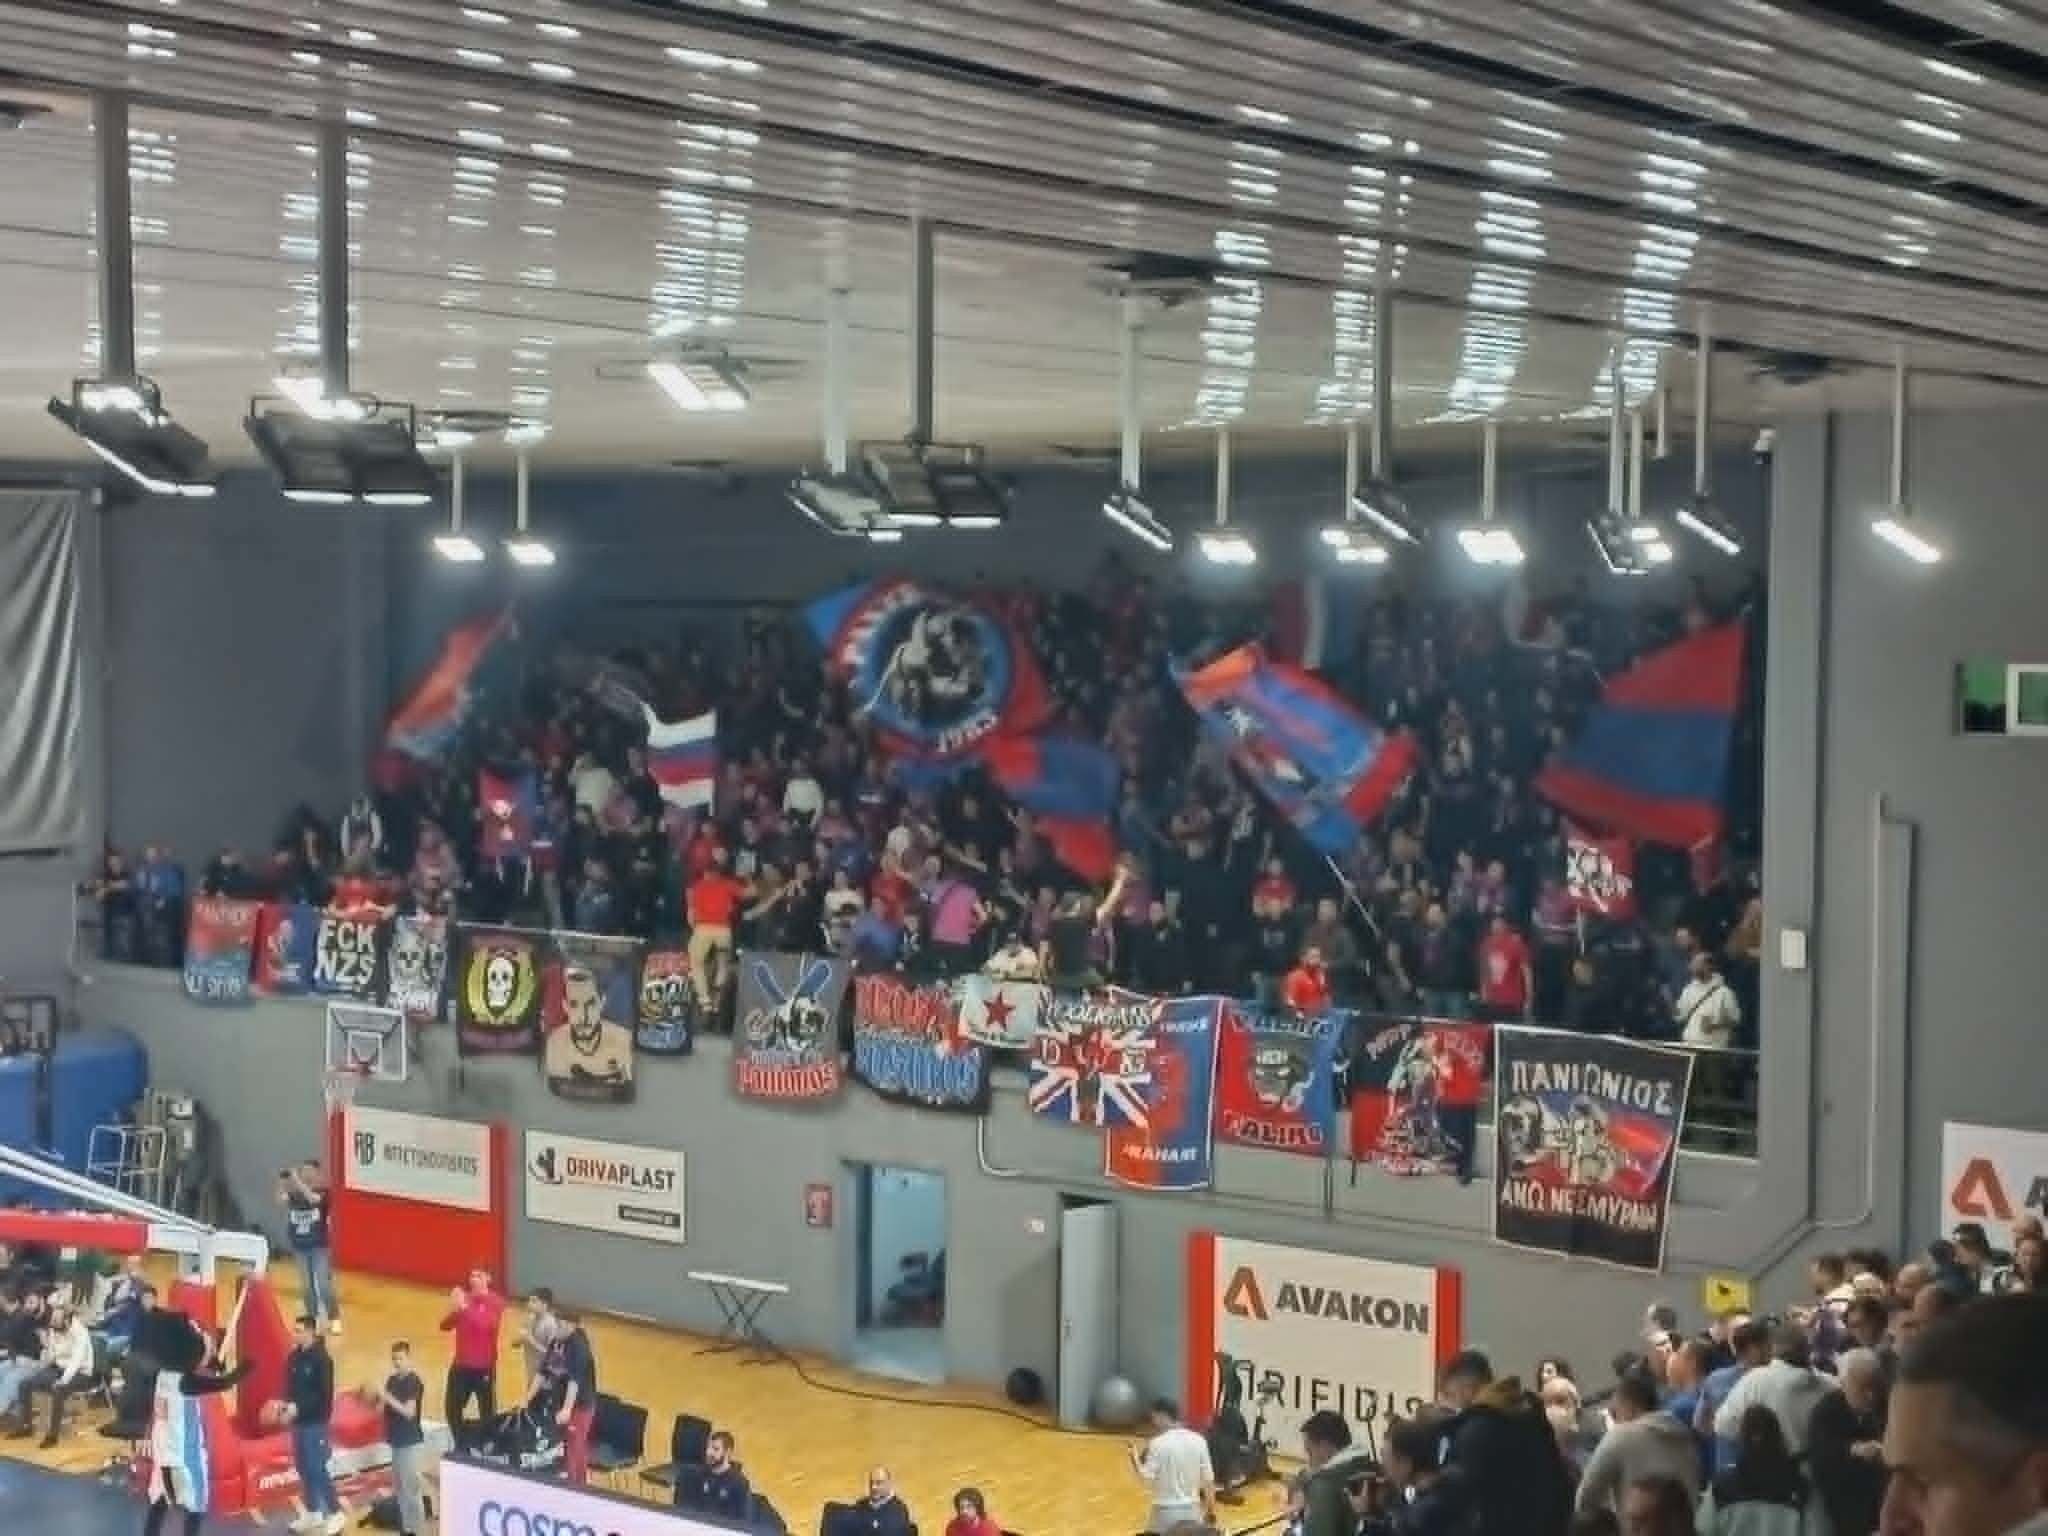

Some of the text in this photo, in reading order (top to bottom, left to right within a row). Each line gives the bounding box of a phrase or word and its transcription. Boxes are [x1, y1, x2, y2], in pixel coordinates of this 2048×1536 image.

[317, 919, 376, 953] FCK
[314, 951, 376, 986] NZS
[1511, 1060, 1673, 1116] ΠΑΝΙΩΝΙΟΣ
[567, 1157, 676, 1191] DRIVAPLAST
[1276, 1282, 1429, 1334] AVAKON
